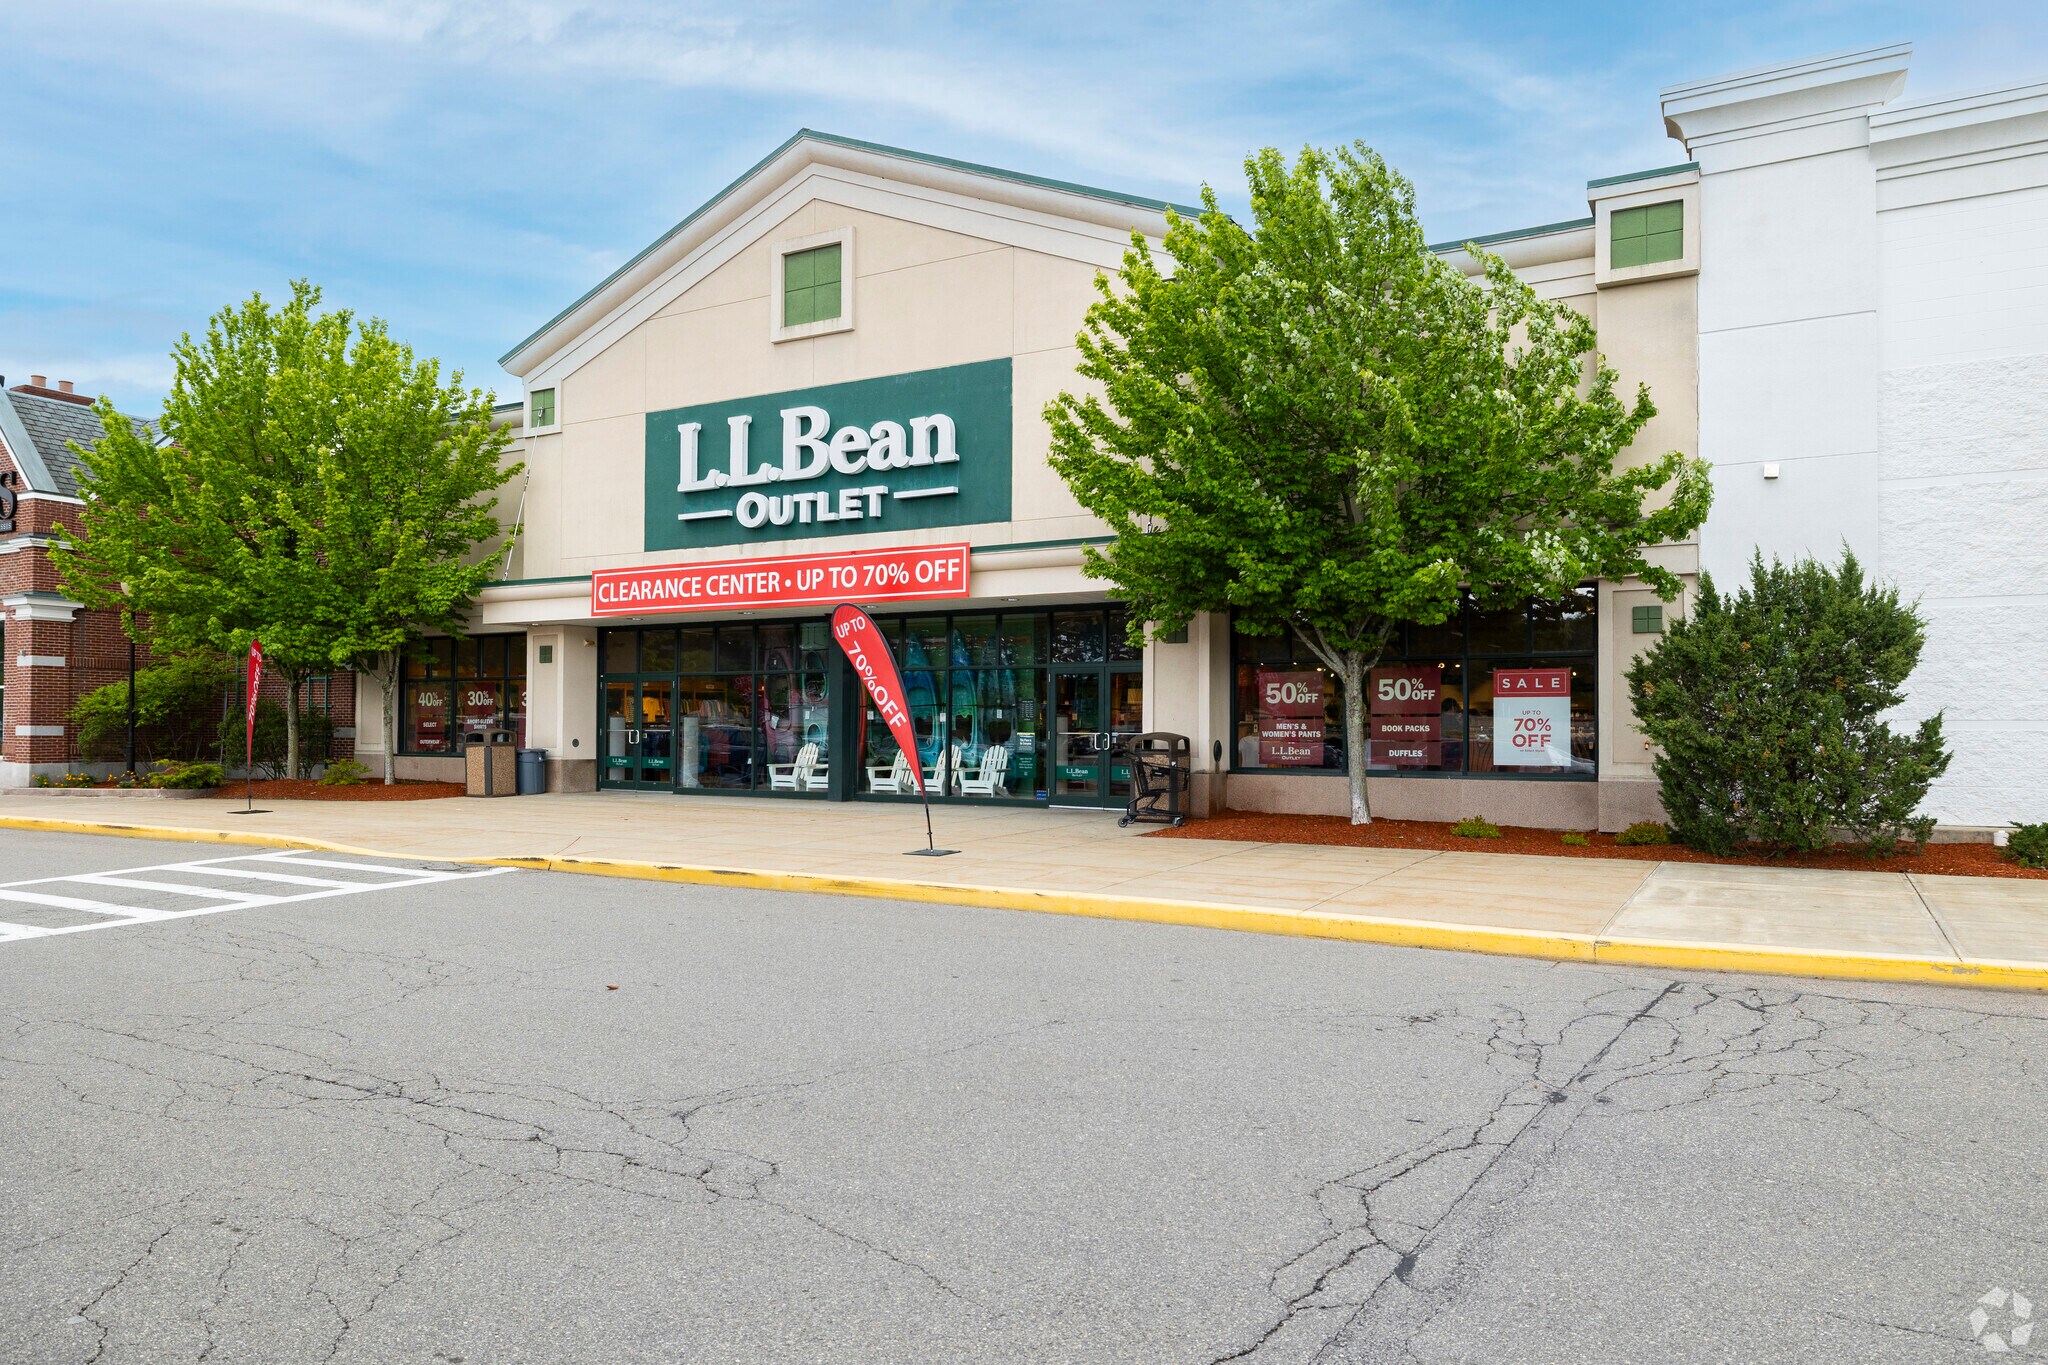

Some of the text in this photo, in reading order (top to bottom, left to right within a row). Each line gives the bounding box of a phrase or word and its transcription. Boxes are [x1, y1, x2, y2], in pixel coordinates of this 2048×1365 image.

[678, 406, 960, 492] L.L.Bean
[736, 485, 889, 528] OUTLET
[598, 558, 960, 603] CLEARANCE CENTER UP TO 70% OFF
[836, 616, 866, 639] UP TO
[1502, 677, 1560, 689] SALE
[1297, 694, 1319, 703] OFF
[1411, 690, 1436, 700] OFF
[1513, 718, 1552, 732] 70%
[1512, 734, 1551, 747] OFF
[1272, 746, 1311, 755] L.L.Bean
[1388, 749, 1423, 757] DUFFLES
